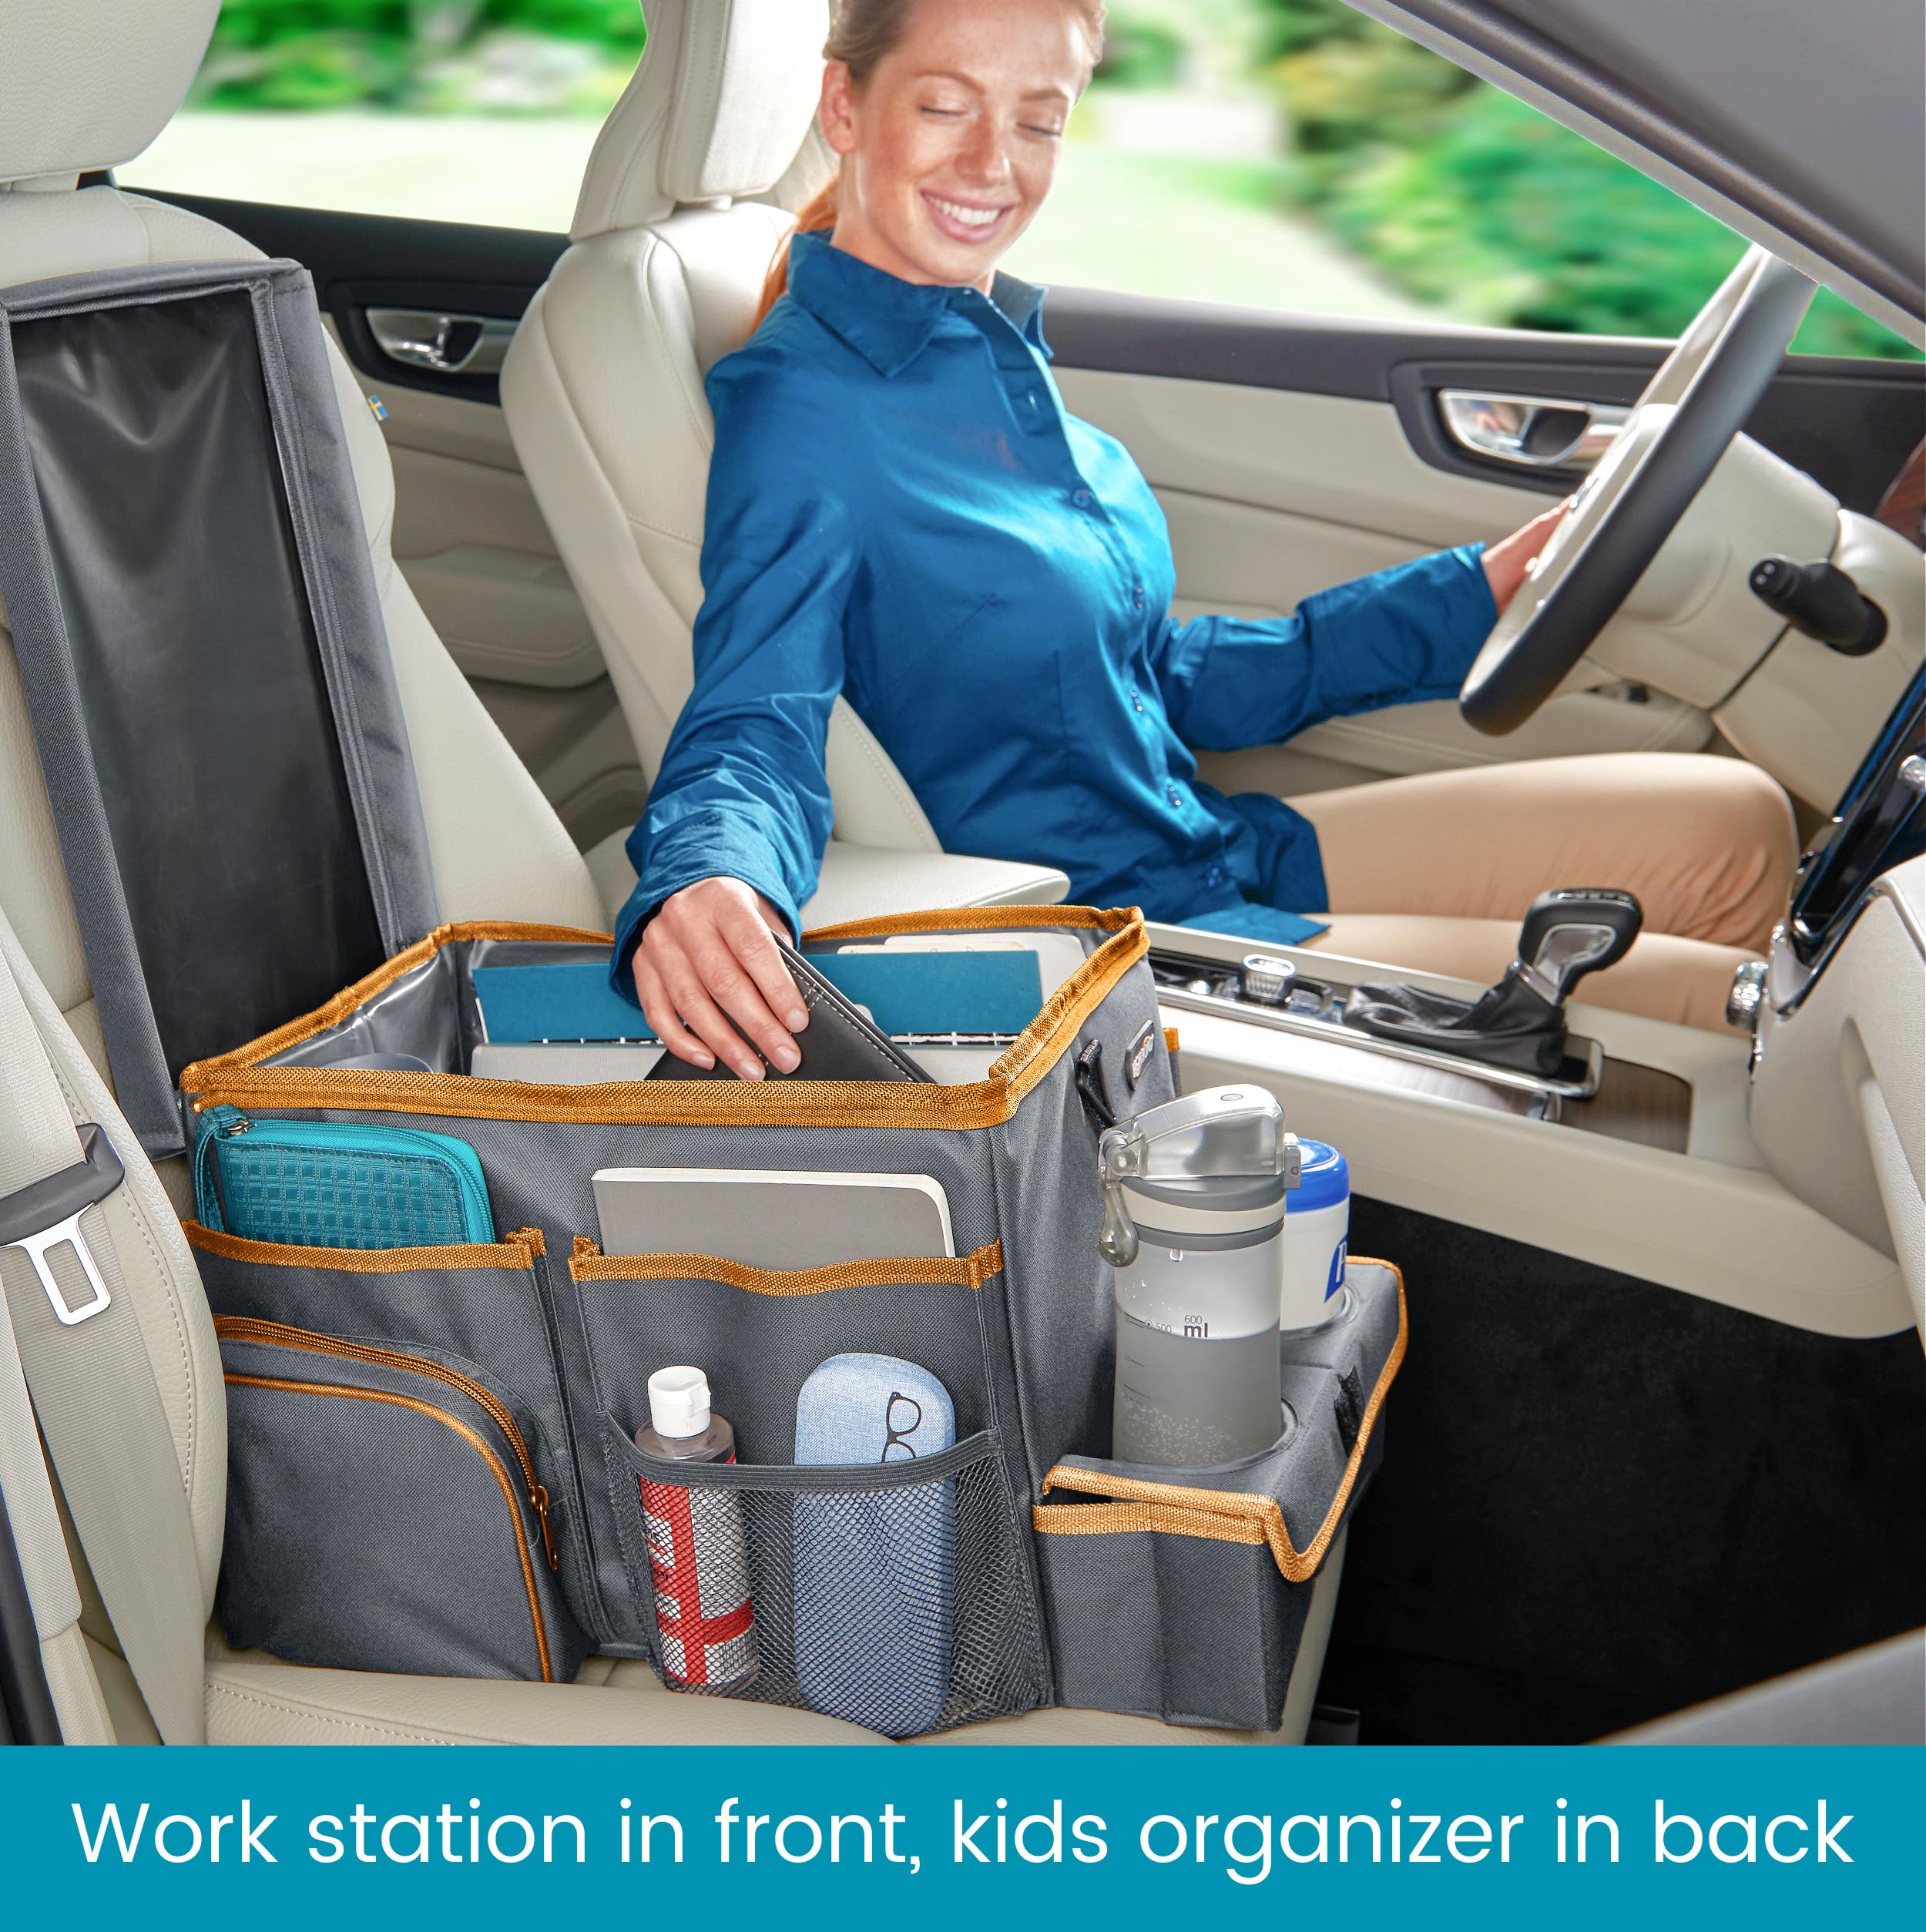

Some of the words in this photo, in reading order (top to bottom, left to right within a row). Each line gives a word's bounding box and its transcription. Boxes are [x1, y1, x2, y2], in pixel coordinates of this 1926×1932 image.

[1184, 1314, 1203, 1325] 600
[1156, 1322, 1172, 1334] 500
[1184, 1323, 1209, 1338] ml
